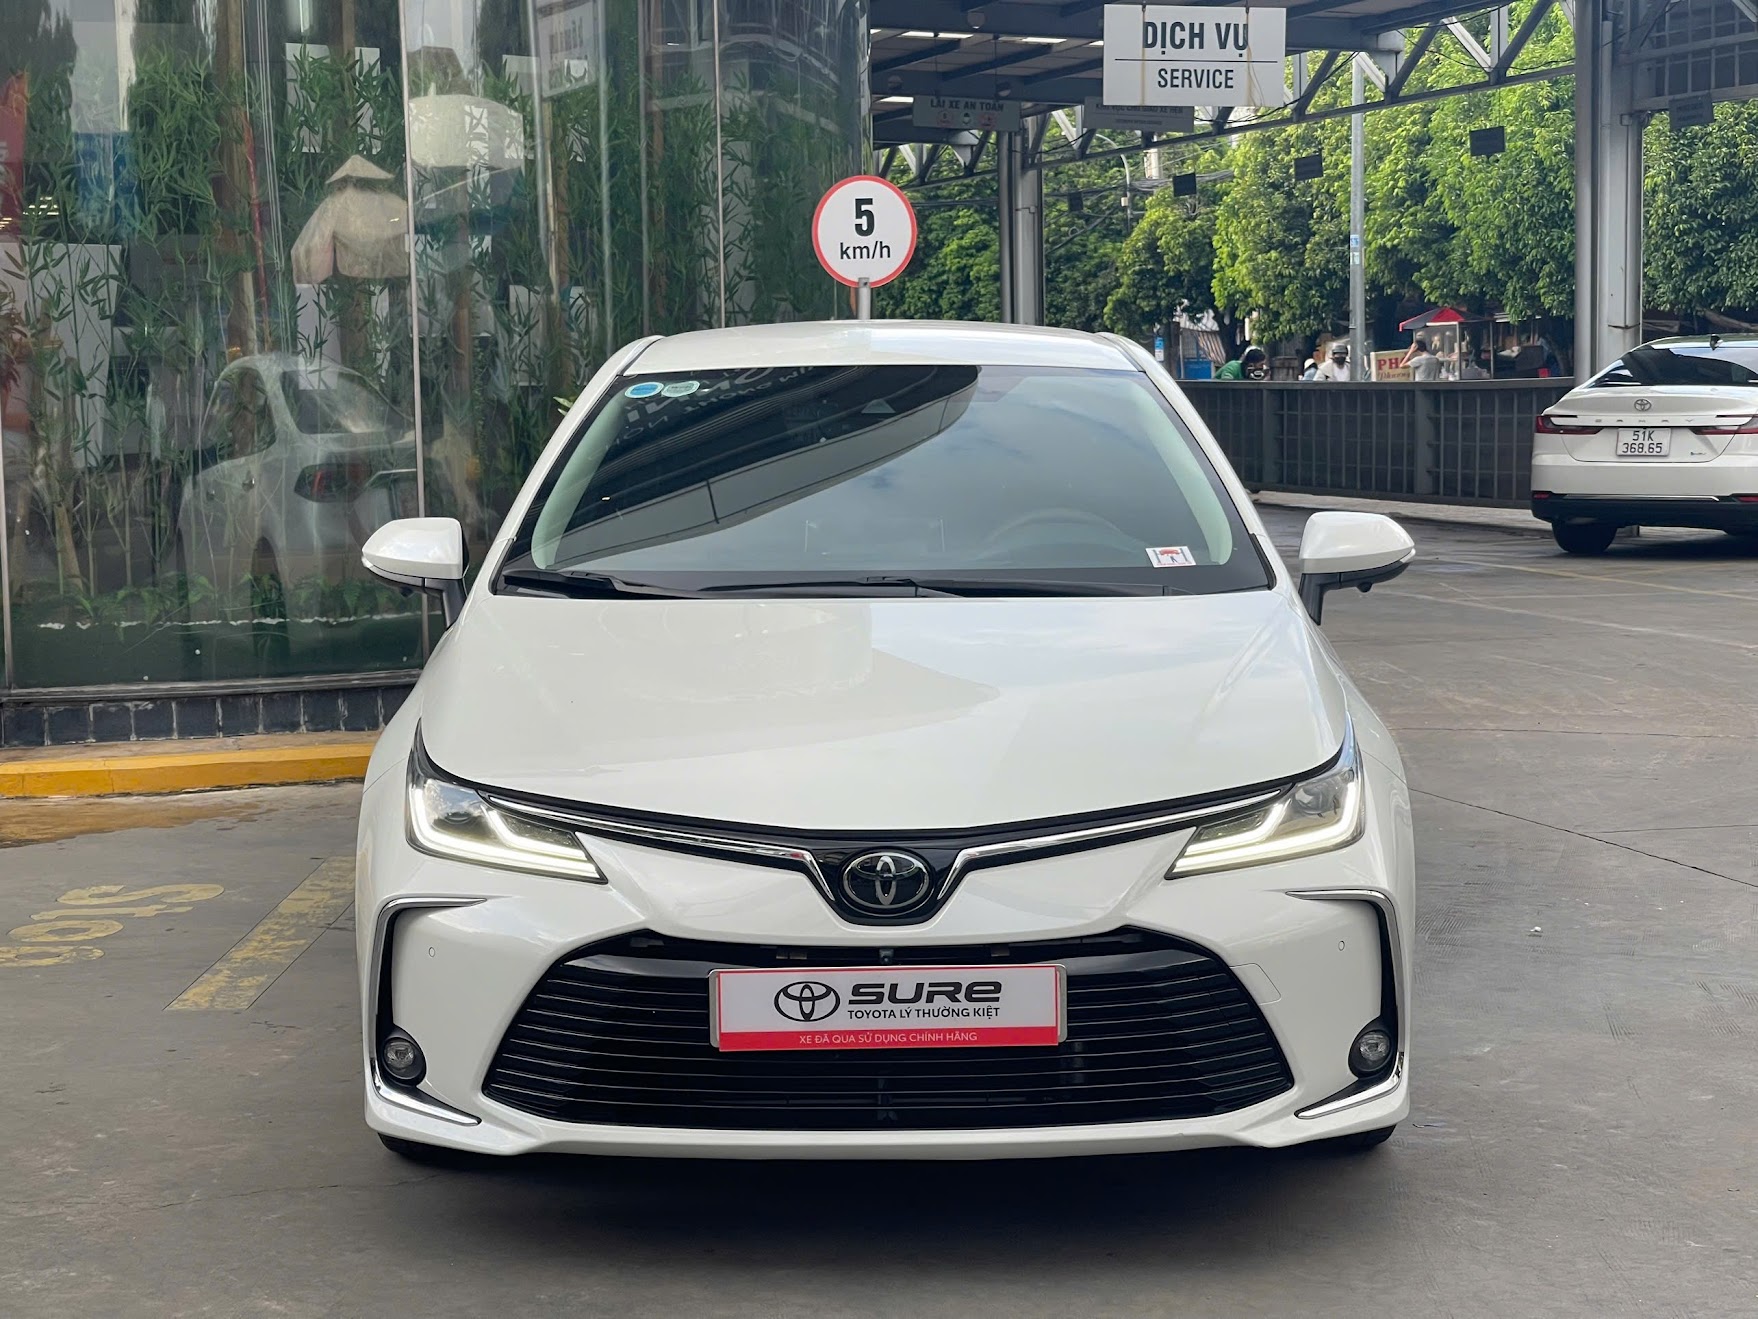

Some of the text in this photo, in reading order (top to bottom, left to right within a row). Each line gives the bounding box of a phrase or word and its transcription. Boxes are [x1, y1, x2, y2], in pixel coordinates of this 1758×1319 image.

[1143, 21, 1249, 58] DỊCH VỤ
[1157, 68, 1235, 89] SERVICE
[854, 197, 875, 237] 5
[839, 240, 891, 260] km/h
[1632, 430, 1655, 442] 51K
[1621, 442, 1663, 454] 368.65
[847, 1004, 1001, 1020] TOYOTA LÝ THƯỜNG KIỆT
[799, 1034, 812, 1045] XE
[814, 1032, 829, 1045] ĐÃ
[832, 1034, 856, 1044] QUA
[858, 1031, 873, 1043] SỬ
[874, 1033, 907, 1045] DỤNG
[909, 1030, 944, 1042] CHÍNH
